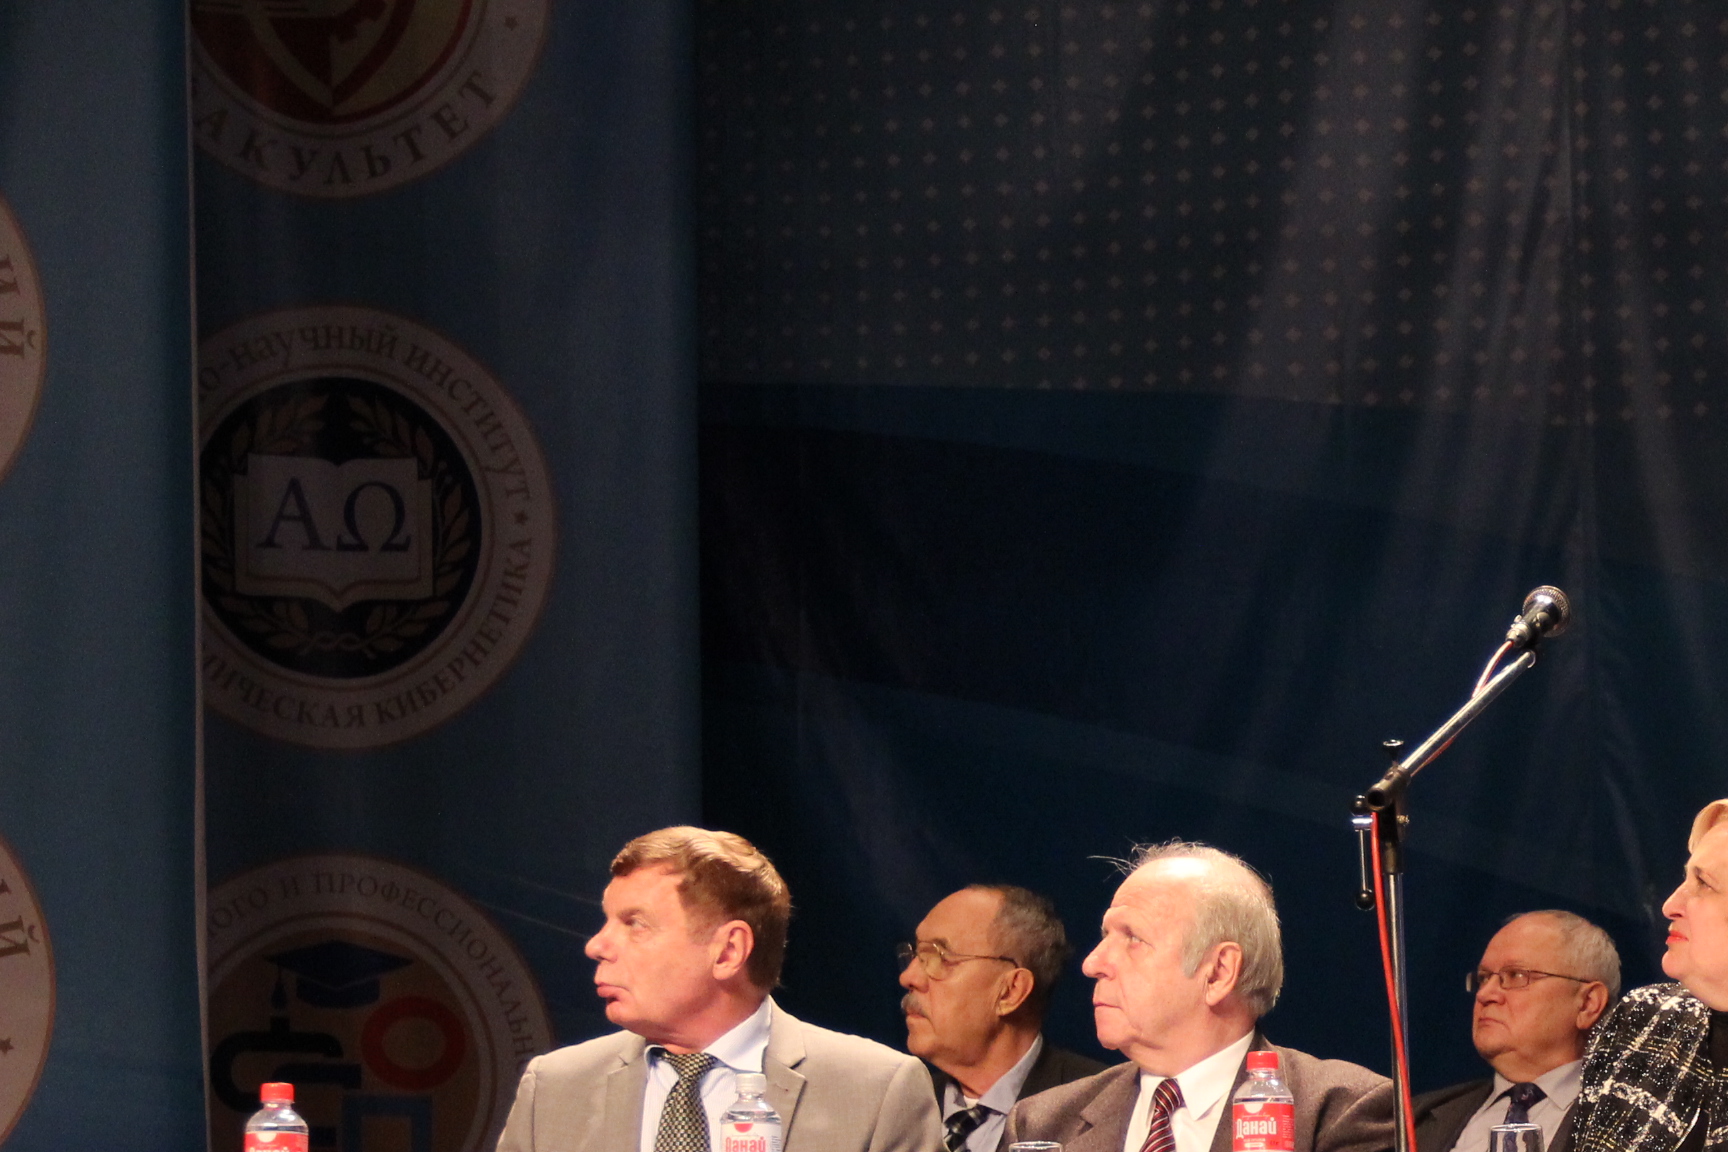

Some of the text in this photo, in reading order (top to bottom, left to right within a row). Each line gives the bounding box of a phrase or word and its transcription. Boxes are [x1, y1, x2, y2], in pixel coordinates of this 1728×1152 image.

[193, 70, 498, 186] АКУЛЬТЕТ
[199, 325, 532, 501] О-НАУЧНЫЙ ИНСТИТУТ
[312, 872, 537, 1066] ПРОФЕССИОНАЛЬН
[1235, 1117, 1277, 1139] Данай
